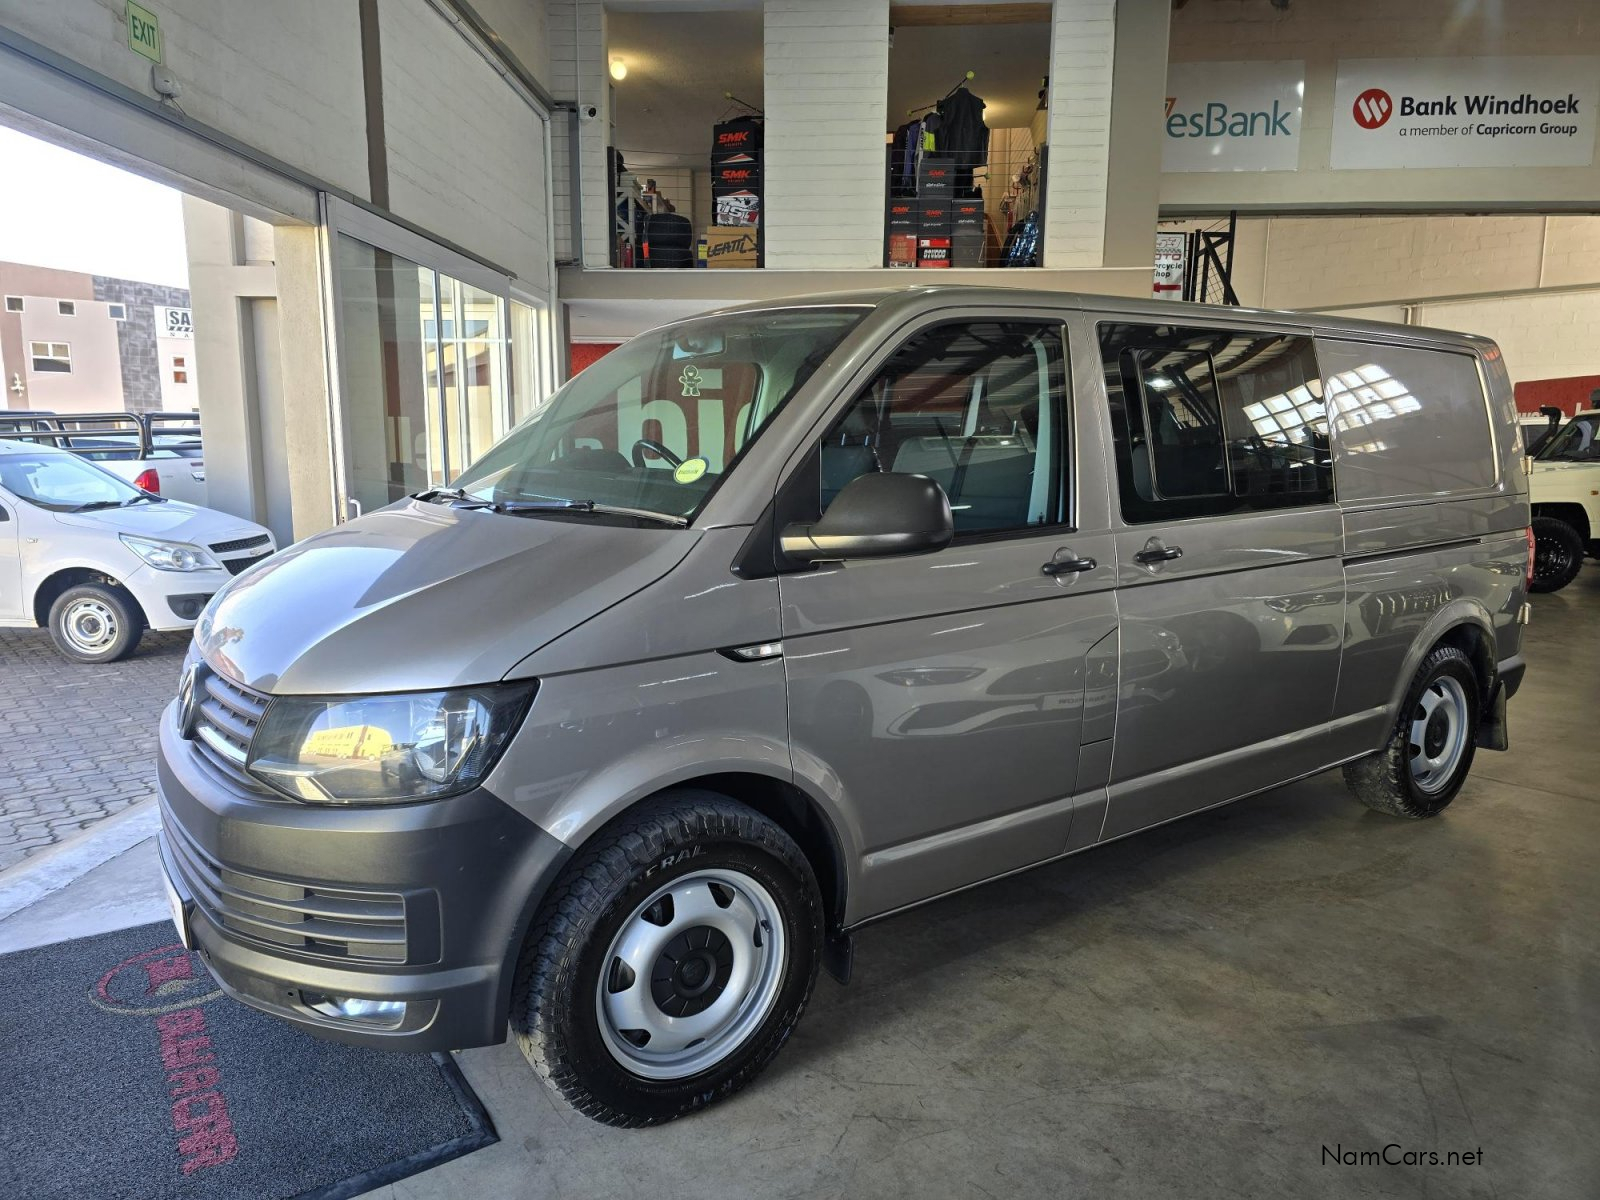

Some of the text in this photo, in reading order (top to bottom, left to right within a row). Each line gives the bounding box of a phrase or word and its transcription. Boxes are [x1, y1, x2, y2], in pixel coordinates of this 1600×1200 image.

[131, 14, 156, 49] EXIT
[1400, 94, 1580, 116] Bank Windhoek
[1399, 123, 1577, 137] a member of Capricorn Group
[718, 131, 749, 144] SMK
[721, 169, 752, 179] SMK
